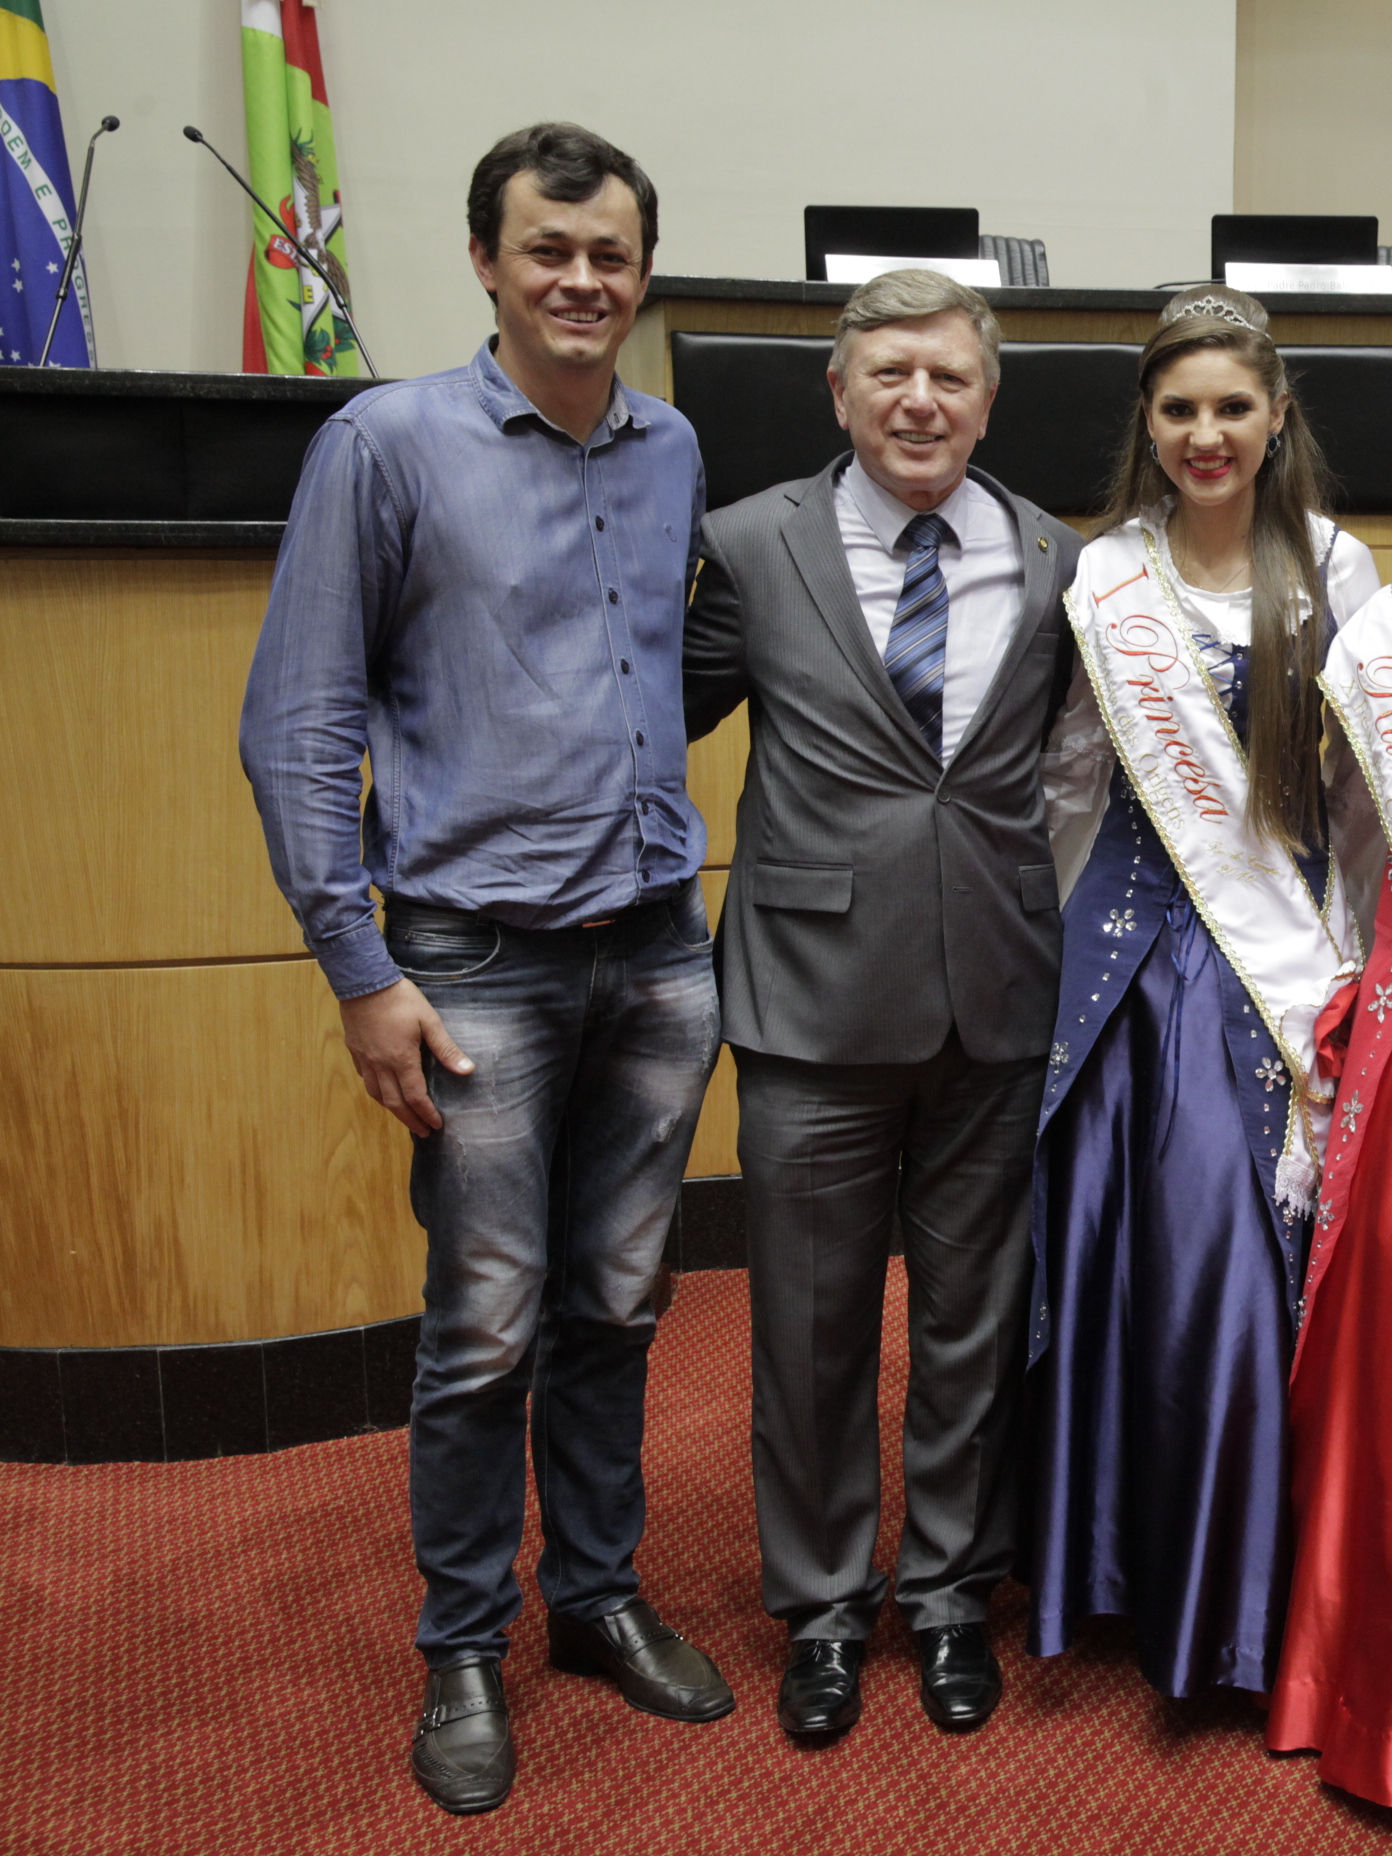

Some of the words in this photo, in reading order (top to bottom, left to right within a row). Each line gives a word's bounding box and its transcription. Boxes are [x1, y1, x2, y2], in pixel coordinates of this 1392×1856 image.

[0, 107, 32, 170] DEM
[35, 184, 52, 200] E
[273, 237, 300, 264] EST
[1298, 281, 1326, 291] Pedro
[1105, 614, 1230, 824] Princesa
[1118, 715, 1139, 747] das
[1138, 753, 1186, 830] Origens
